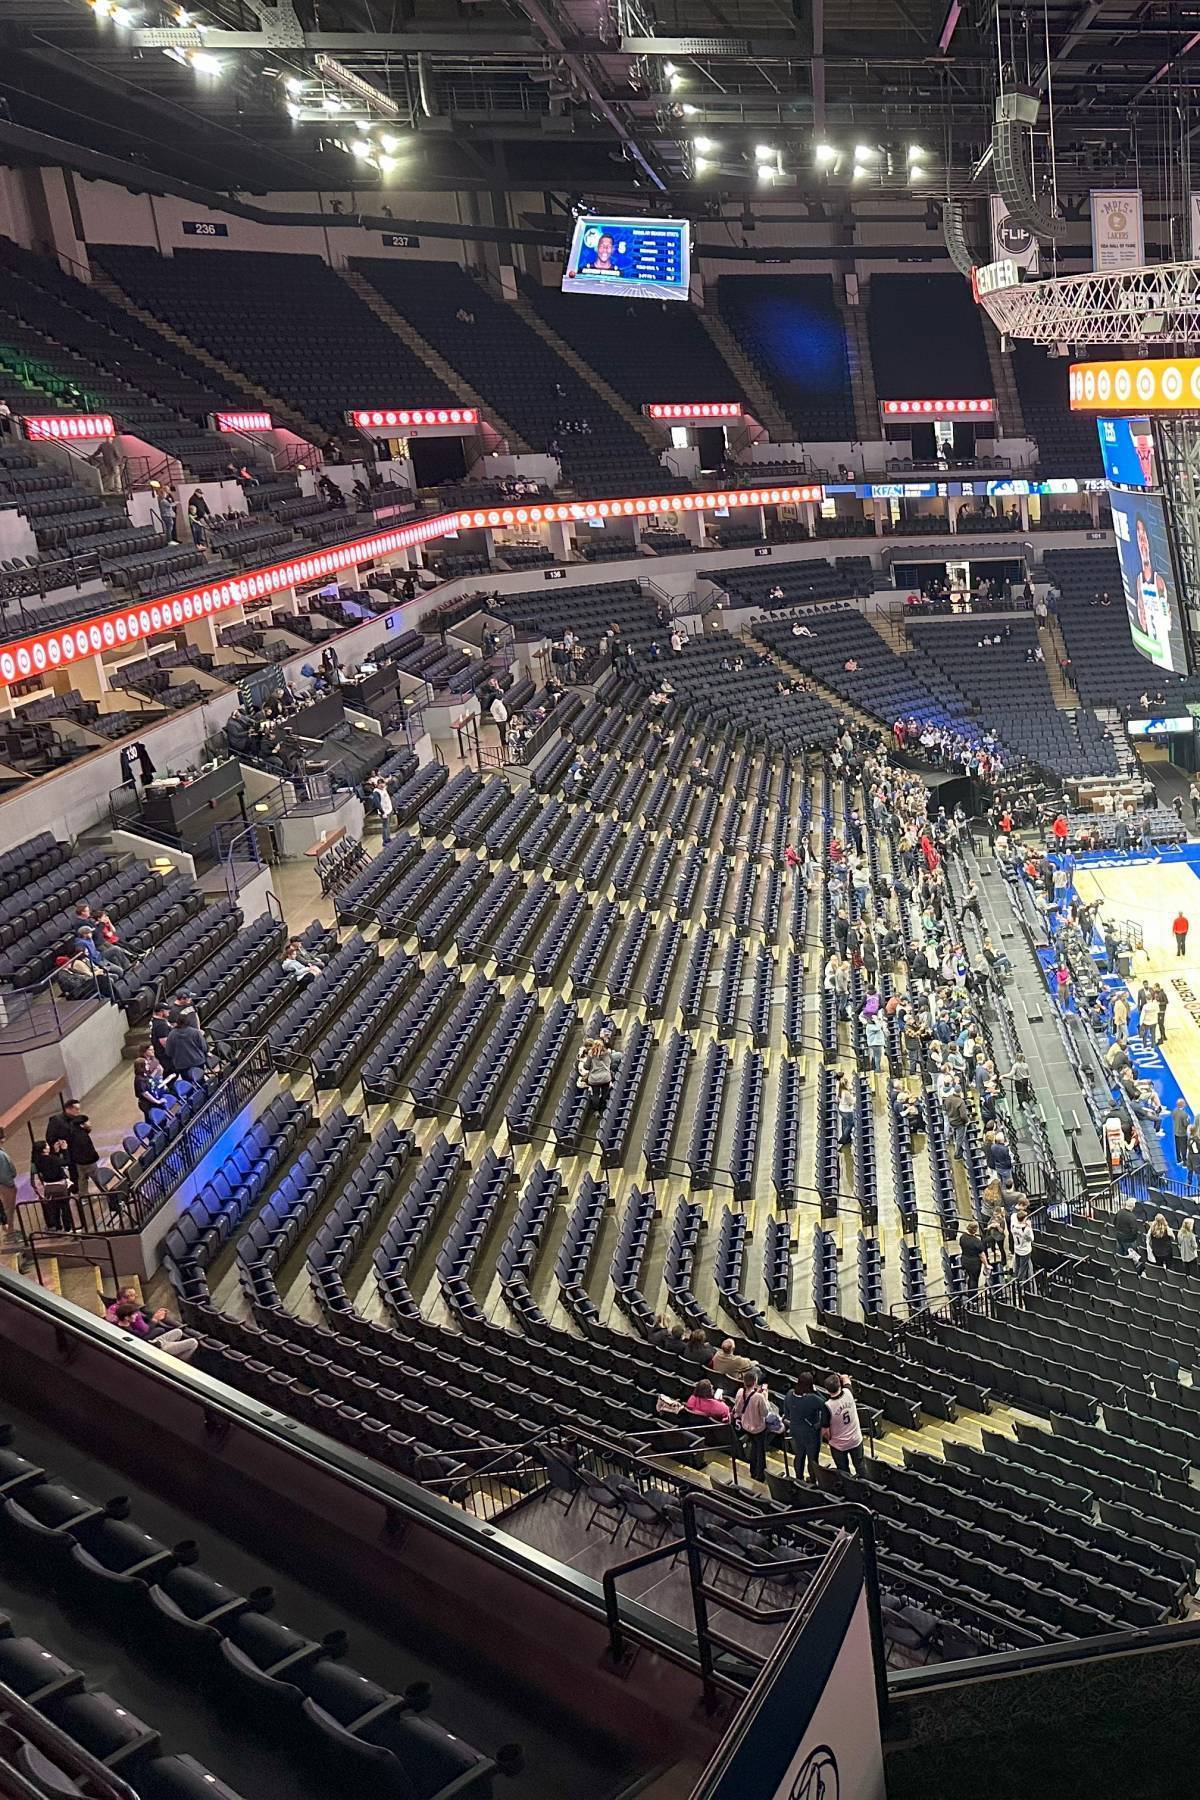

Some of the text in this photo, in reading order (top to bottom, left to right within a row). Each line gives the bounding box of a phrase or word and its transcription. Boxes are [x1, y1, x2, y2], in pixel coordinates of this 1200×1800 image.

[195, 223, 216, 235] 236
[1001, 228, 1030, 240] FLIP
[392, 236, 409, 246] 237
[873, 486, 902, 497] KFAN
[126, 744, 138, 760] 130
[1170, 977, 1197, 1003] CENTER
[842, 1410, 852, 1426] 5
